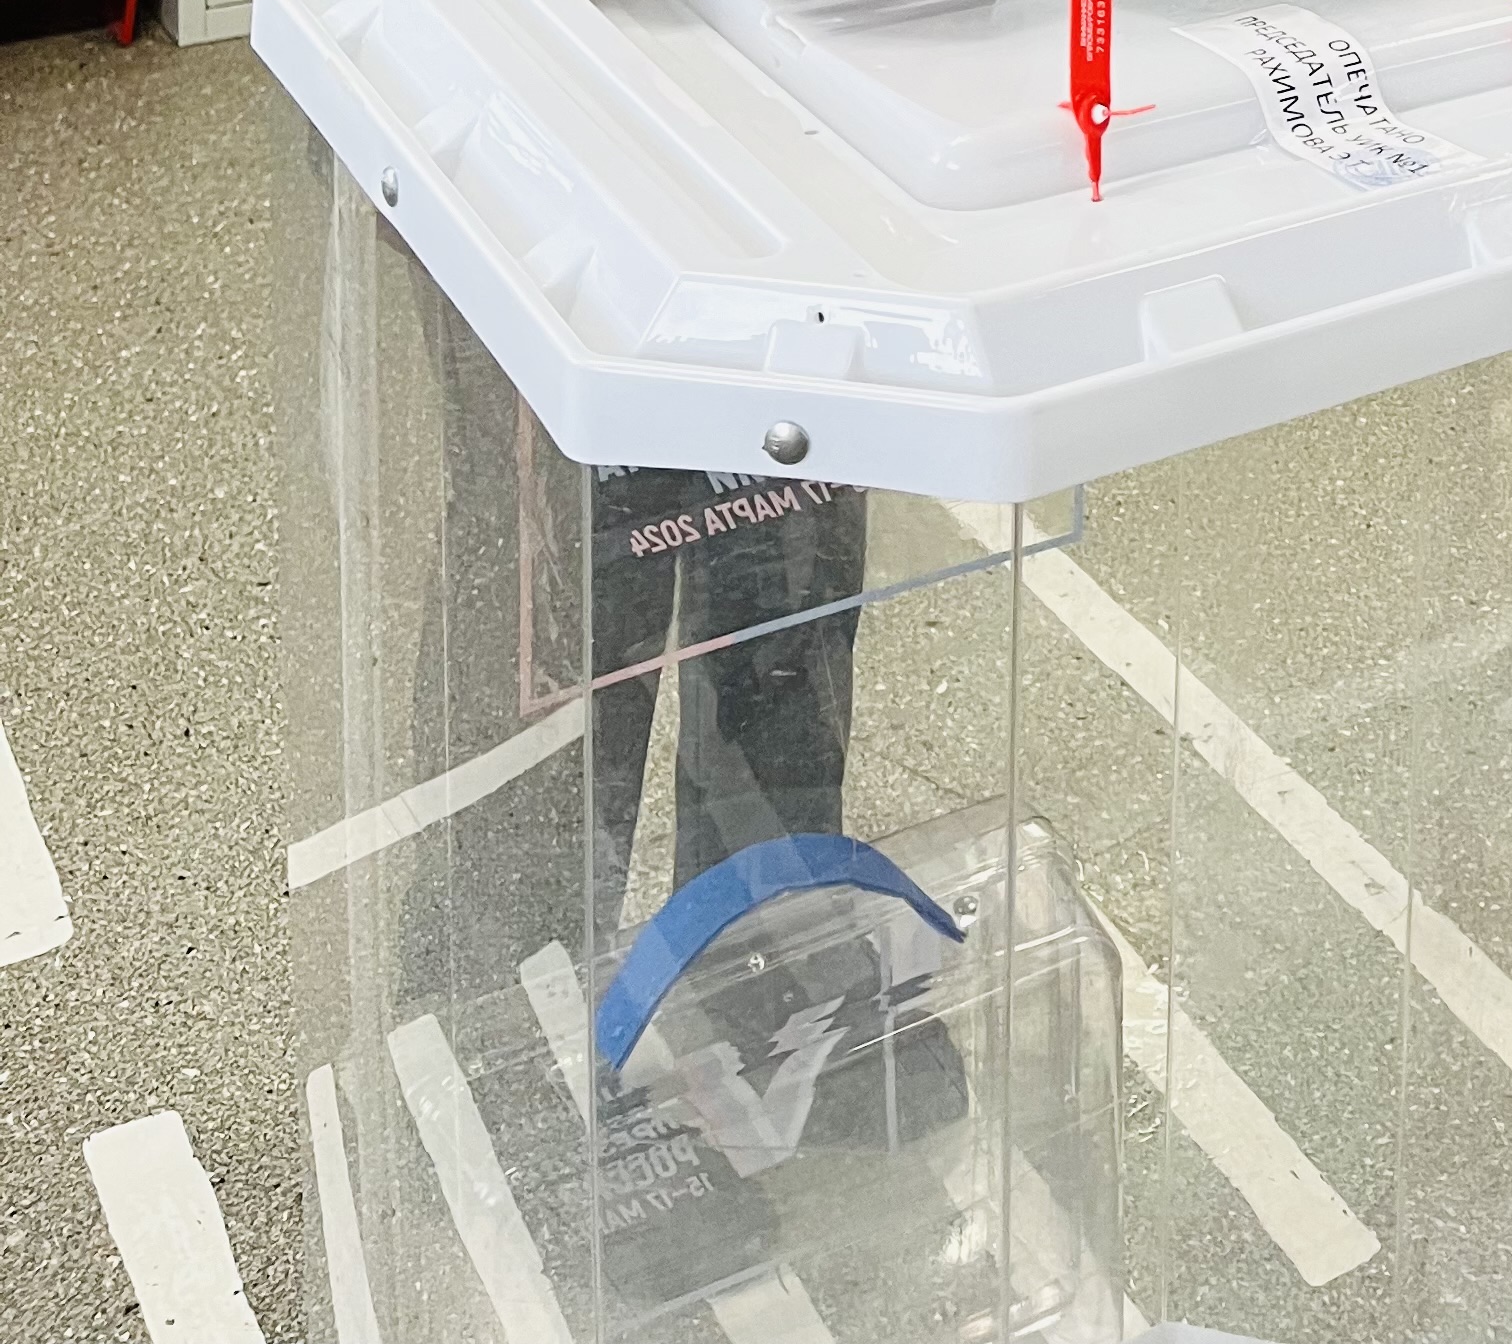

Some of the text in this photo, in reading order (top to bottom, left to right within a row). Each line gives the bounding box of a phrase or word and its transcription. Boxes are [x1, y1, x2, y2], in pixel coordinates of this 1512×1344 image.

[1234, 15, 1347, 135] ПРЕДСЕДАТЕЛЬ
[1244, 48, 1334, 154] РАХИМОВА
[1328, 39, 1425, 144] ОПЕЧАТАНО
